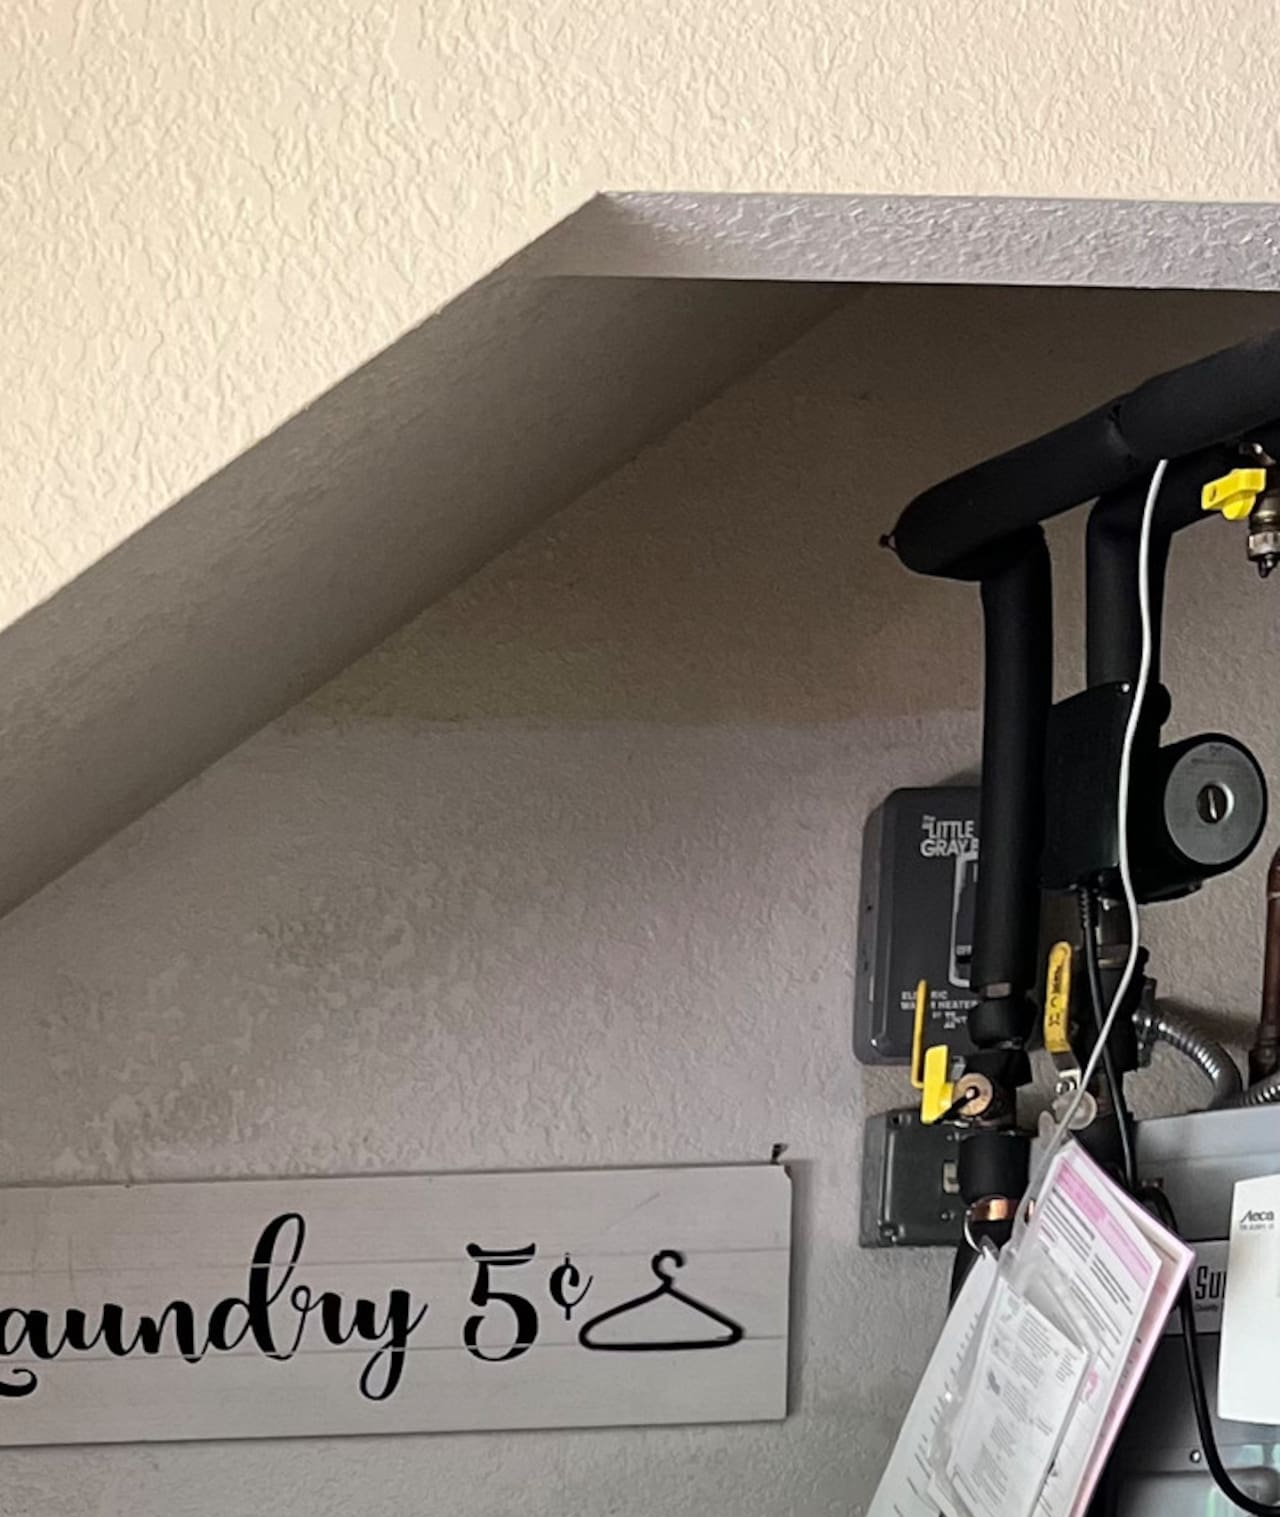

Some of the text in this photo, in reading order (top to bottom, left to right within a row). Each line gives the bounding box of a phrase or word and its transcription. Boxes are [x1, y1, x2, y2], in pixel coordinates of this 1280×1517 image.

[928, 820, 975, 839] LITTLE
[920, 838, 968, 858] GRAY
[462, 1241, 595, 1362] 5¢
